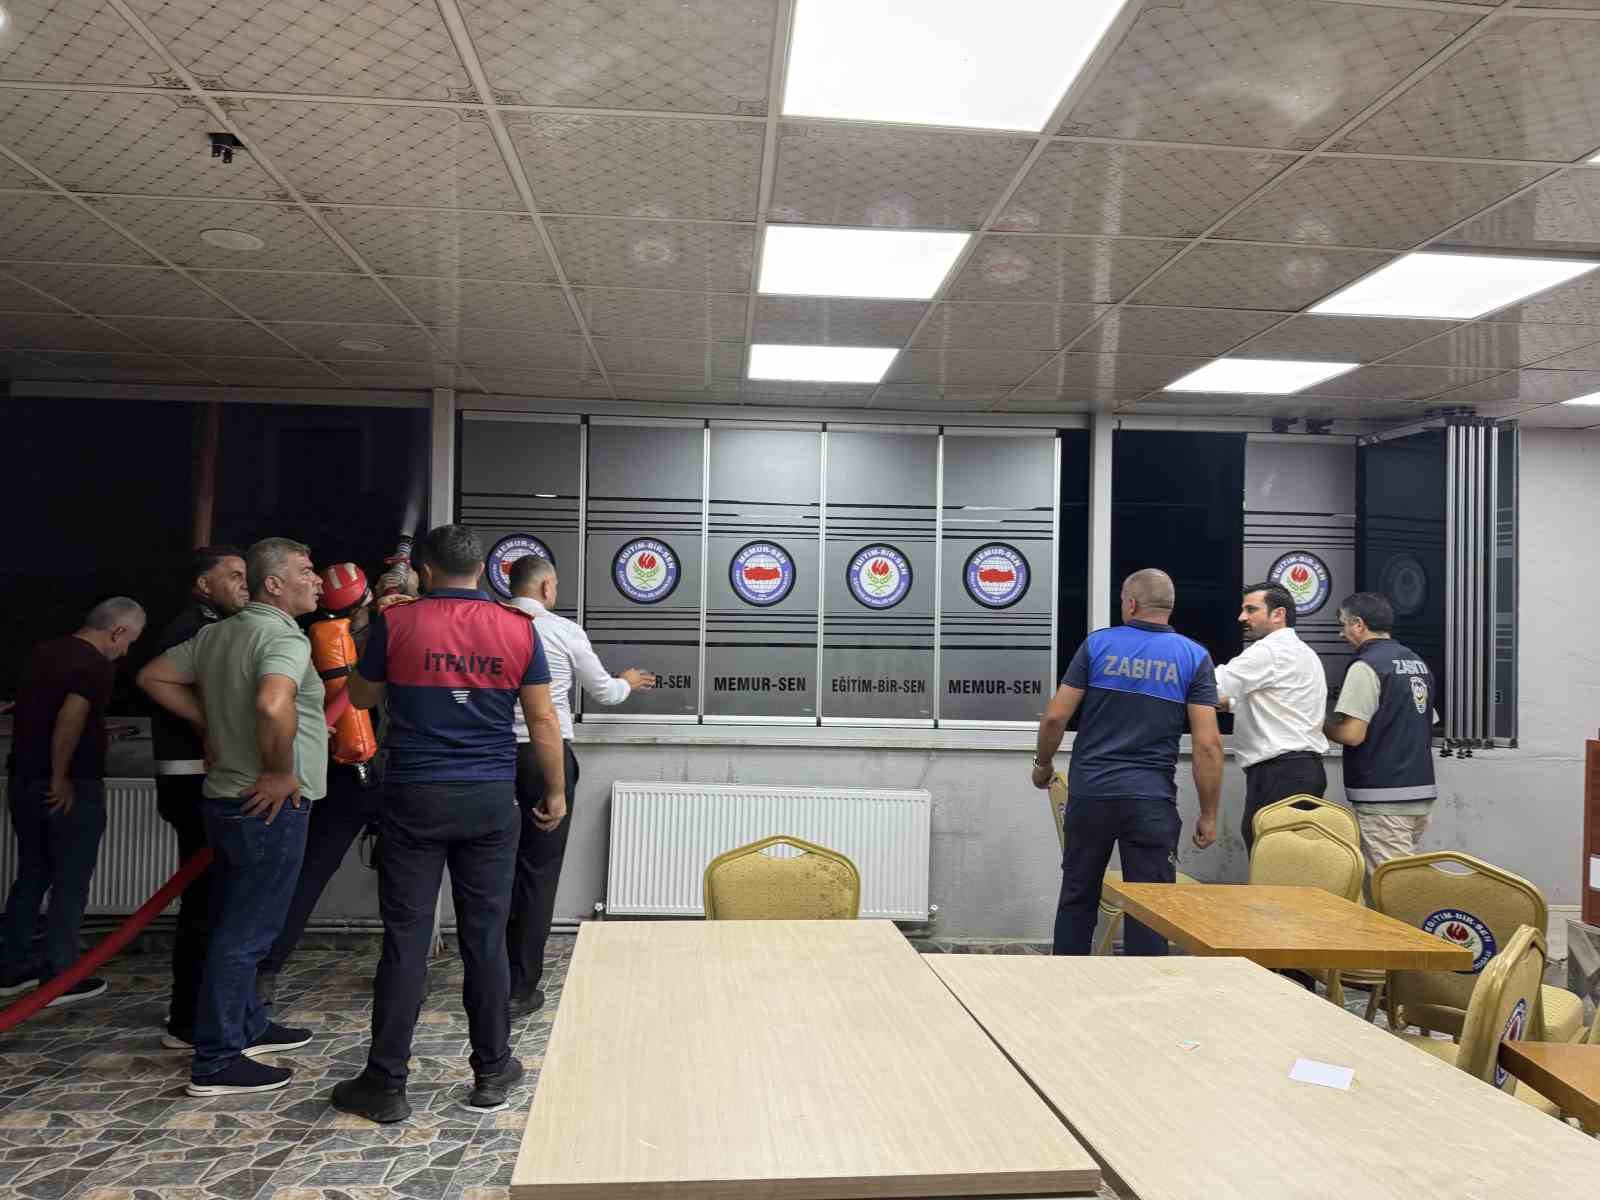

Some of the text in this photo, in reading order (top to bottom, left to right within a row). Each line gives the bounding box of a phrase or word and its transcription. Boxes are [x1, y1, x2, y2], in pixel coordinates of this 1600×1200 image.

[738, 546, 786, 564] MEMUR-SEN
[424, 648, 504, 675] İTFAİYE
[1103, 655, 1179, 684] ZABITA
[713, 676, 807, 692] MEMUR-SEN
[831, 676, 926, 693] EĞİTİM-BİR-SEN
[948, 679, 1042, 694] MEMUR-SEN
